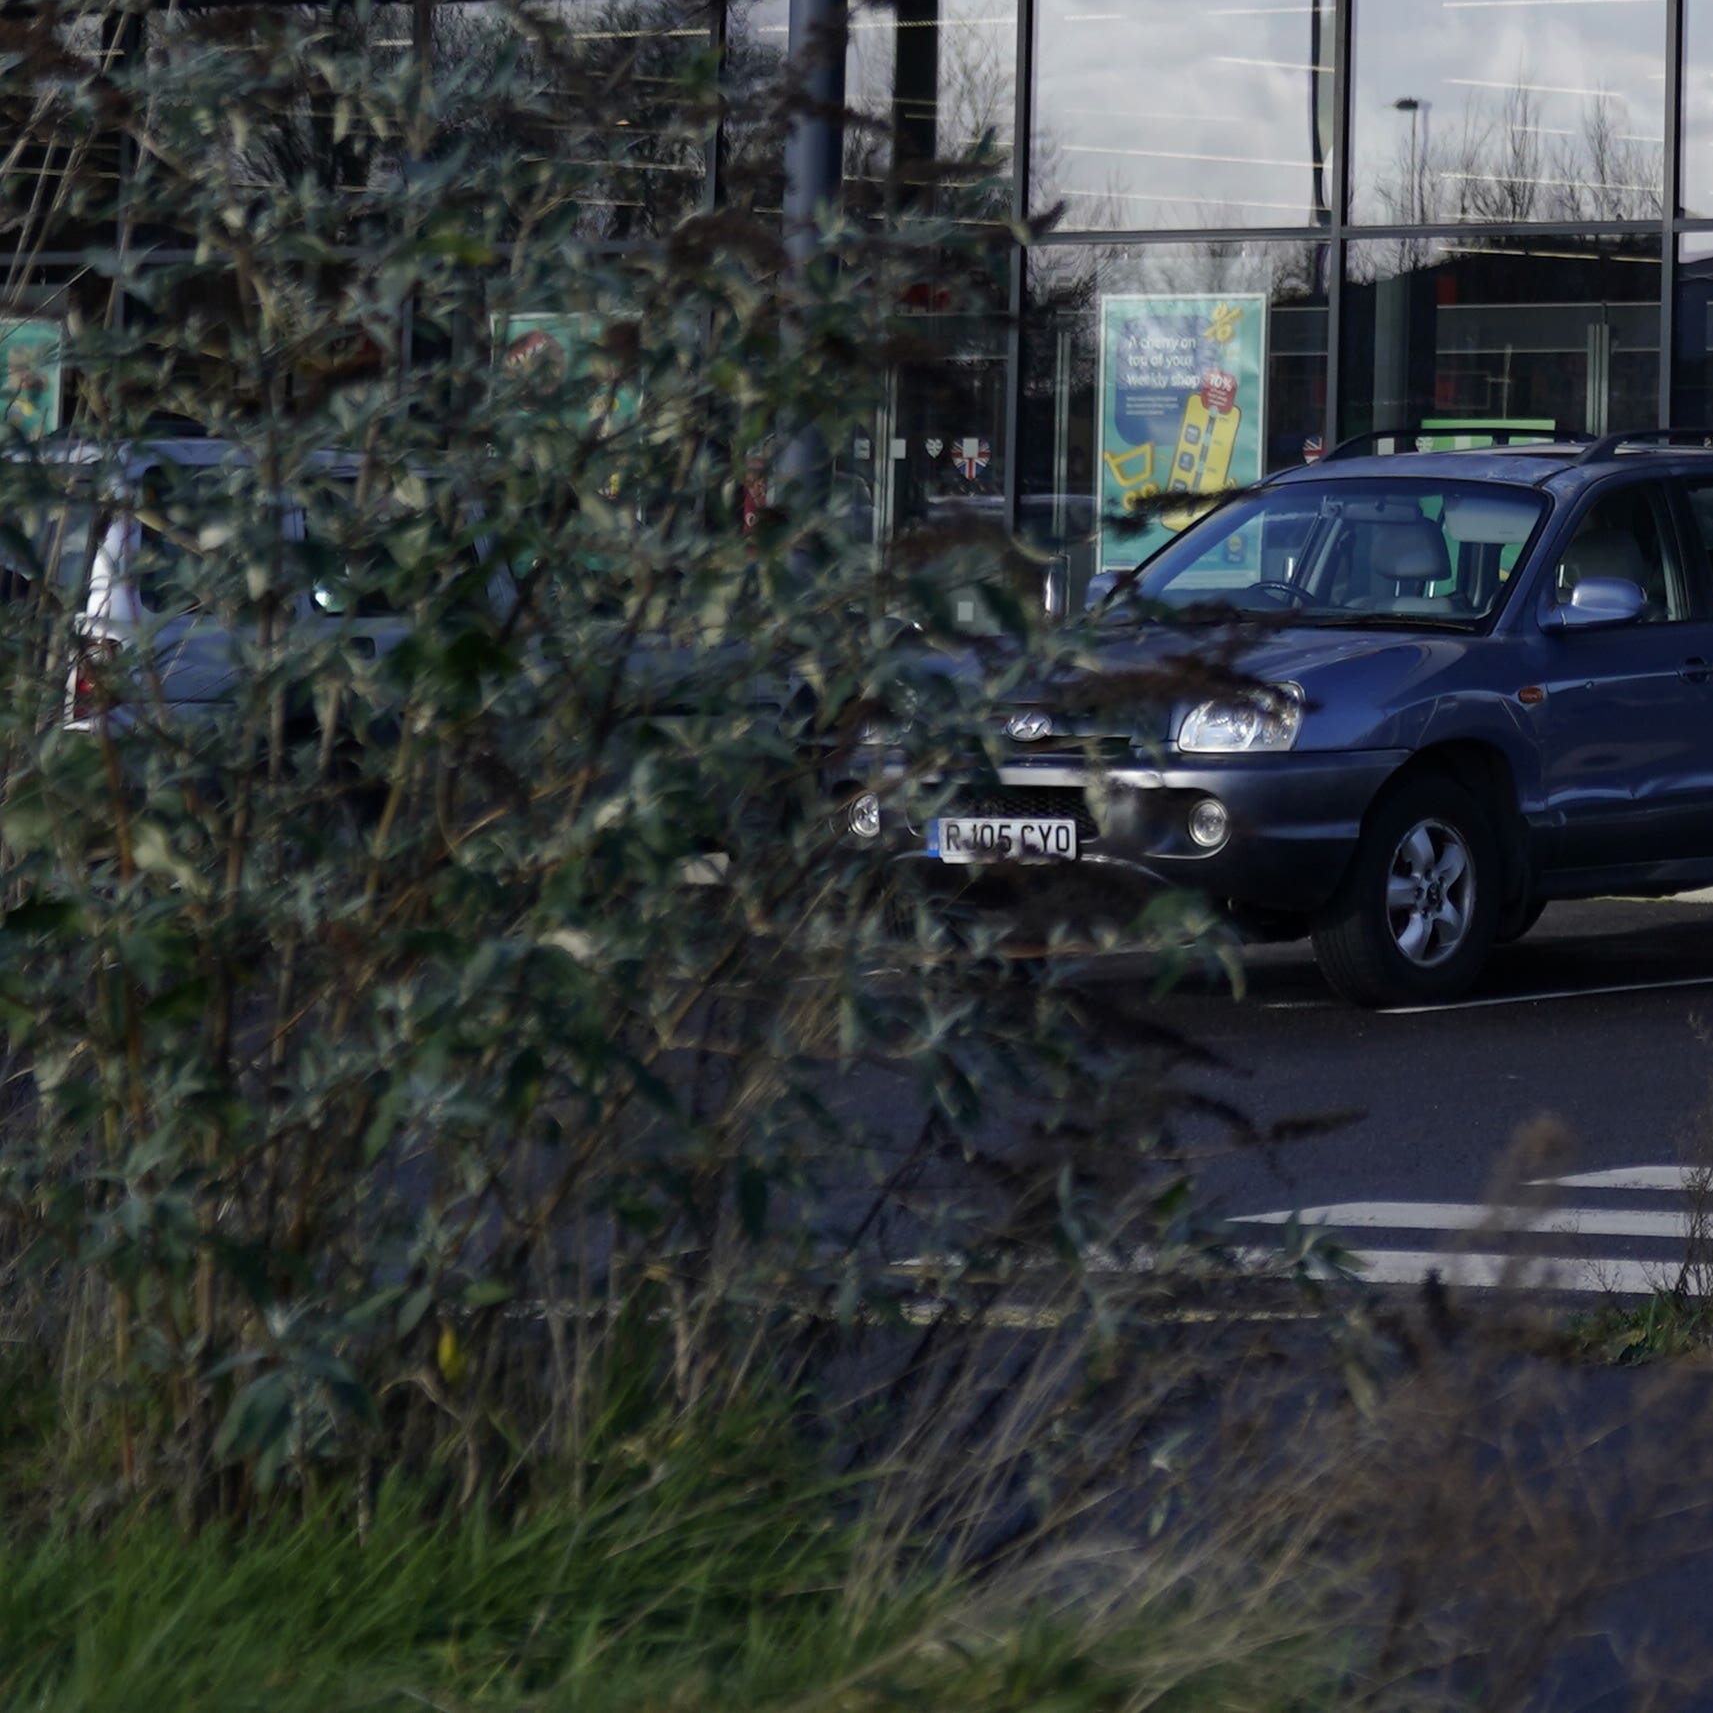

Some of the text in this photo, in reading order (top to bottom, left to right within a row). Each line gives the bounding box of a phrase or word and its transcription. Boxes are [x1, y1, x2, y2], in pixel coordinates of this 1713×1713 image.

[1140, 335, 1179, 352] cherry
[1180, 338, 1196, 349] on
[1128, 354, 1193, 369] top of your
[1170, 373, 1201, 388] shop
